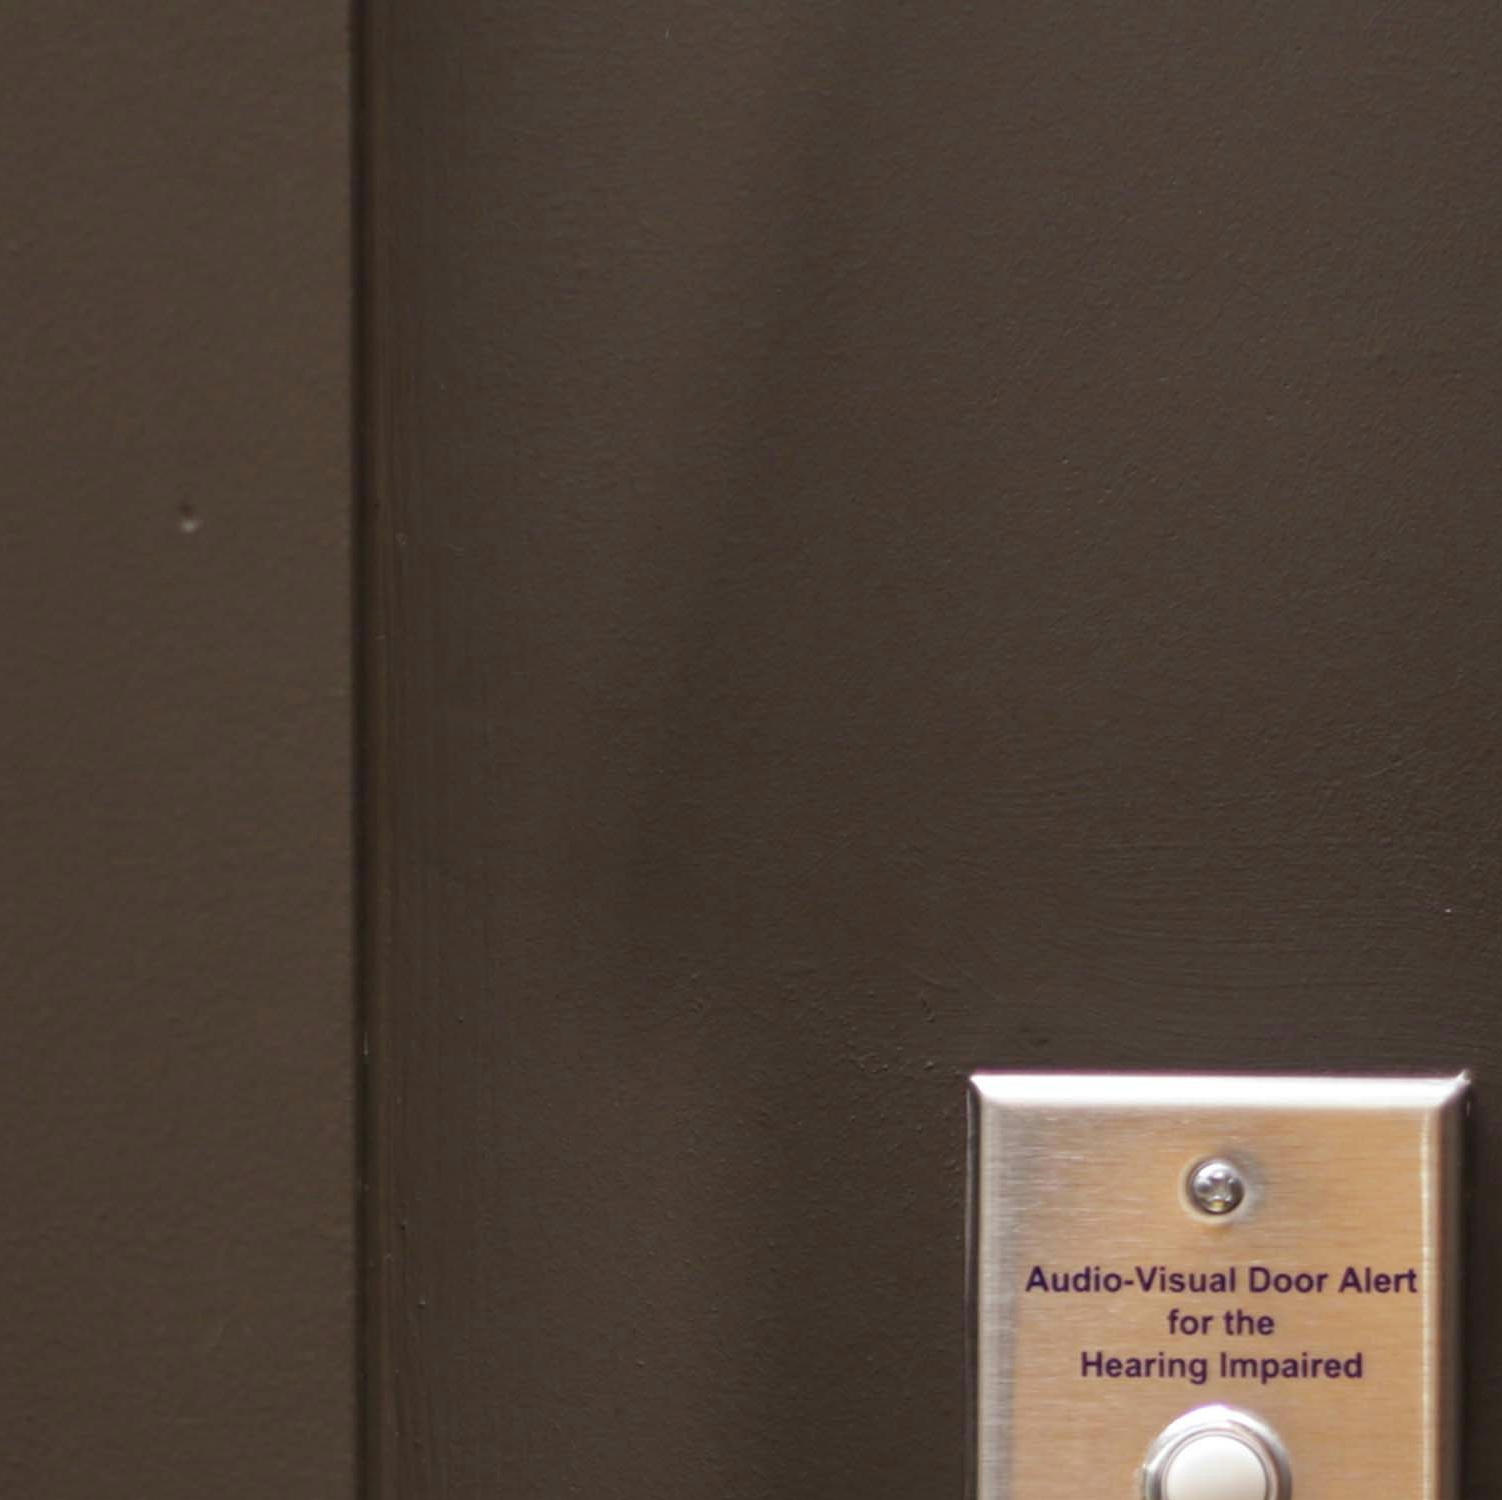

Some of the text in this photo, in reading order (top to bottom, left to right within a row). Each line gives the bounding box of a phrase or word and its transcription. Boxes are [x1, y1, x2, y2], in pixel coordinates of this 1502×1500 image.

[1025, 1266, 1418, 1293] Audio-Visual Door Alert
[1168, 1309, 1275, 1336] for the
[1081, 1352, 1363, 1386] Hearing Impaired
